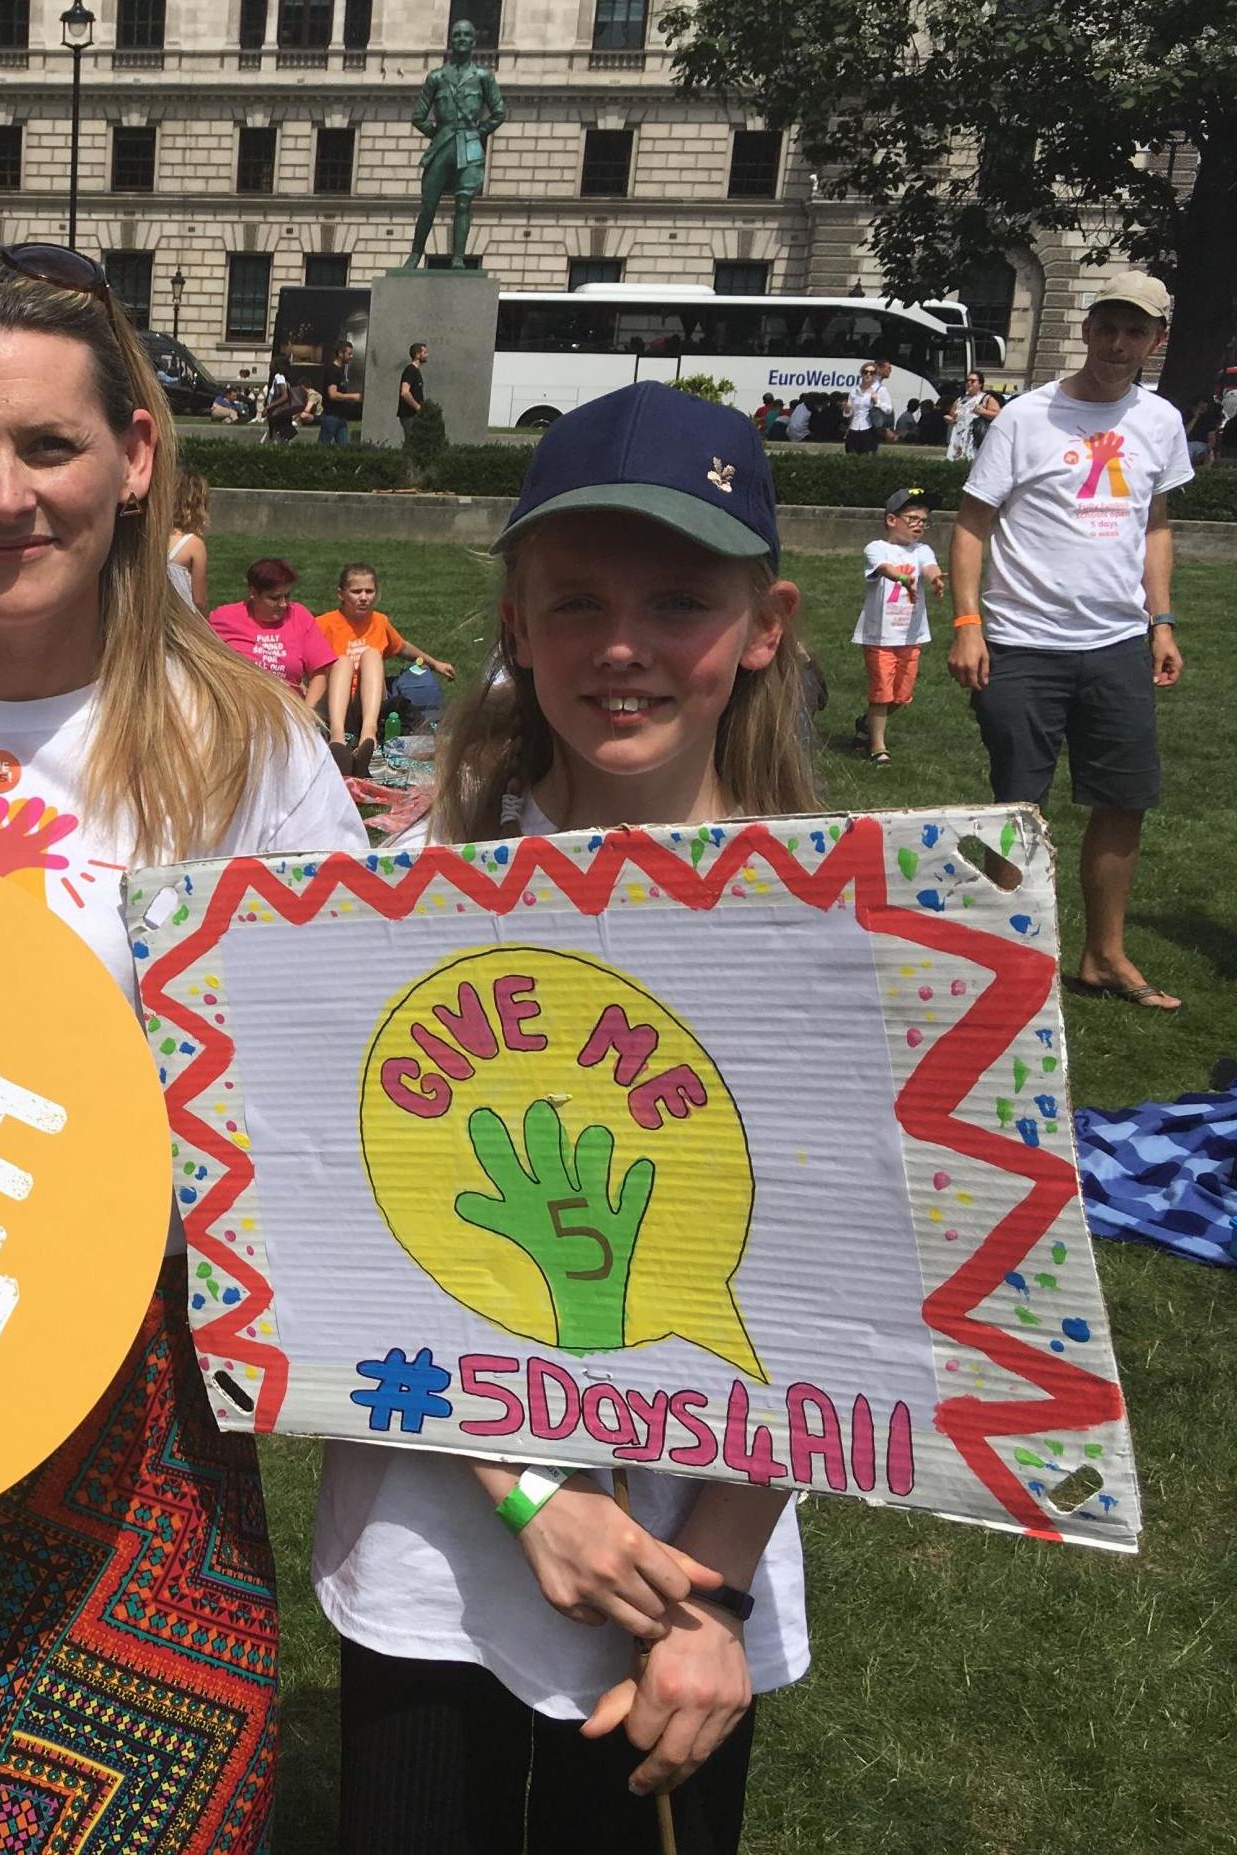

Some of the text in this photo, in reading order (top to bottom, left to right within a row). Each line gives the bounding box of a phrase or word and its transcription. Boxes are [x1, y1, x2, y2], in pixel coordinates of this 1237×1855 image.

[380, 975, 709, 1130] GIVE ME
[546, 1197, 614, 1281] 5
[350, 1347, 915, 1496] #5Days4All
